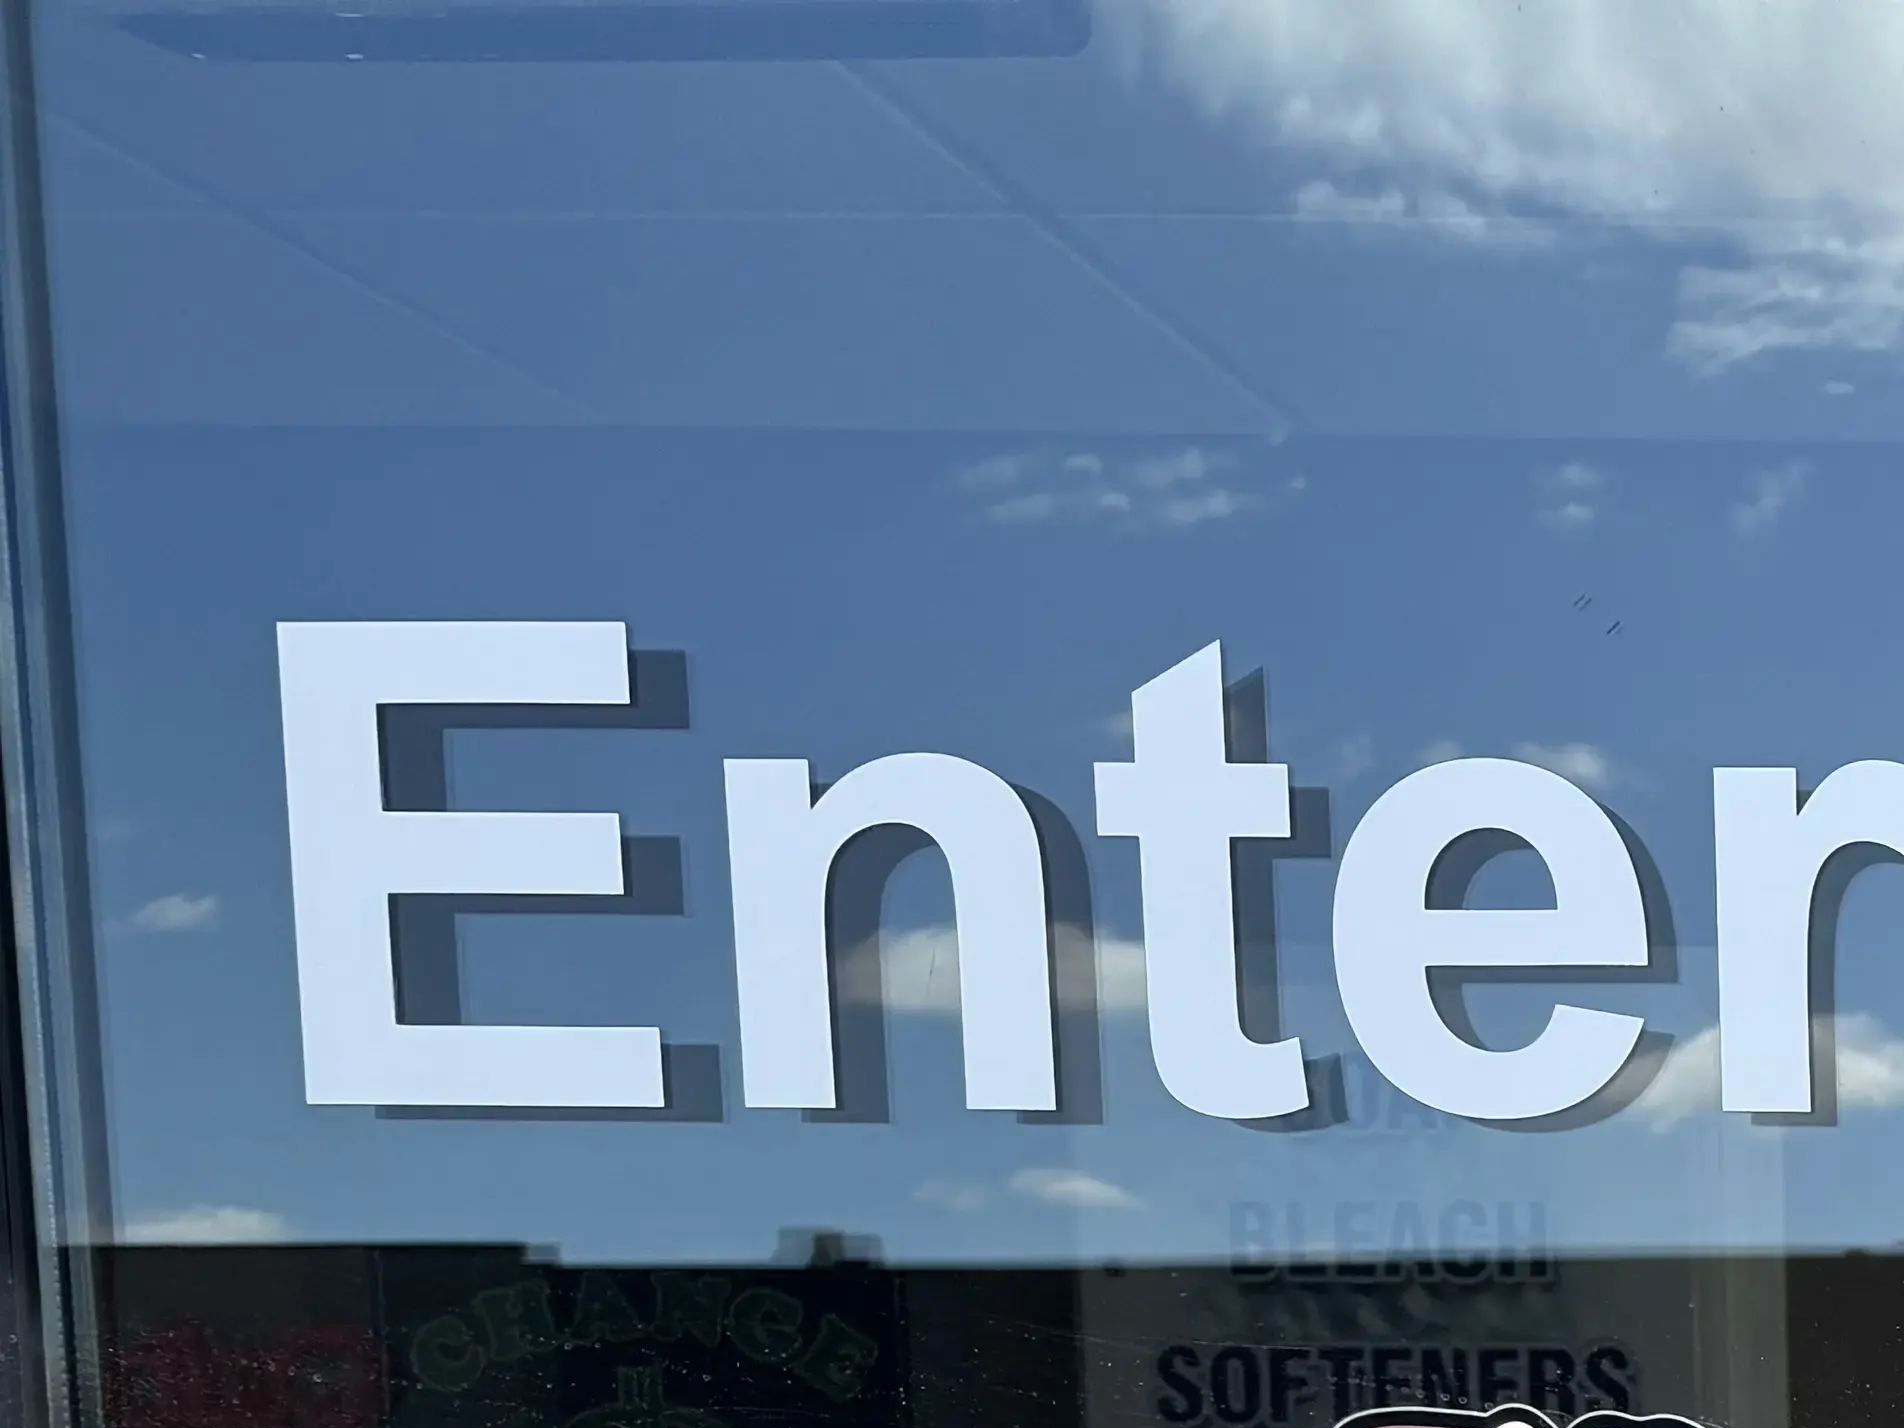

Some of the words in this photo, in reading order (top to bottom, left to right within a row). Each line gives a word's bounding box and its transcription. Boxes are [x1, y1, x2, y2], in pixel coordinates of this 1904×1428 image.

[1229, 1200, 1549, 1280] BLEACH
[410, 1270, 879, 1399] CHANGE
[1157, 1342, 1634, 1425] SOFTENERS
